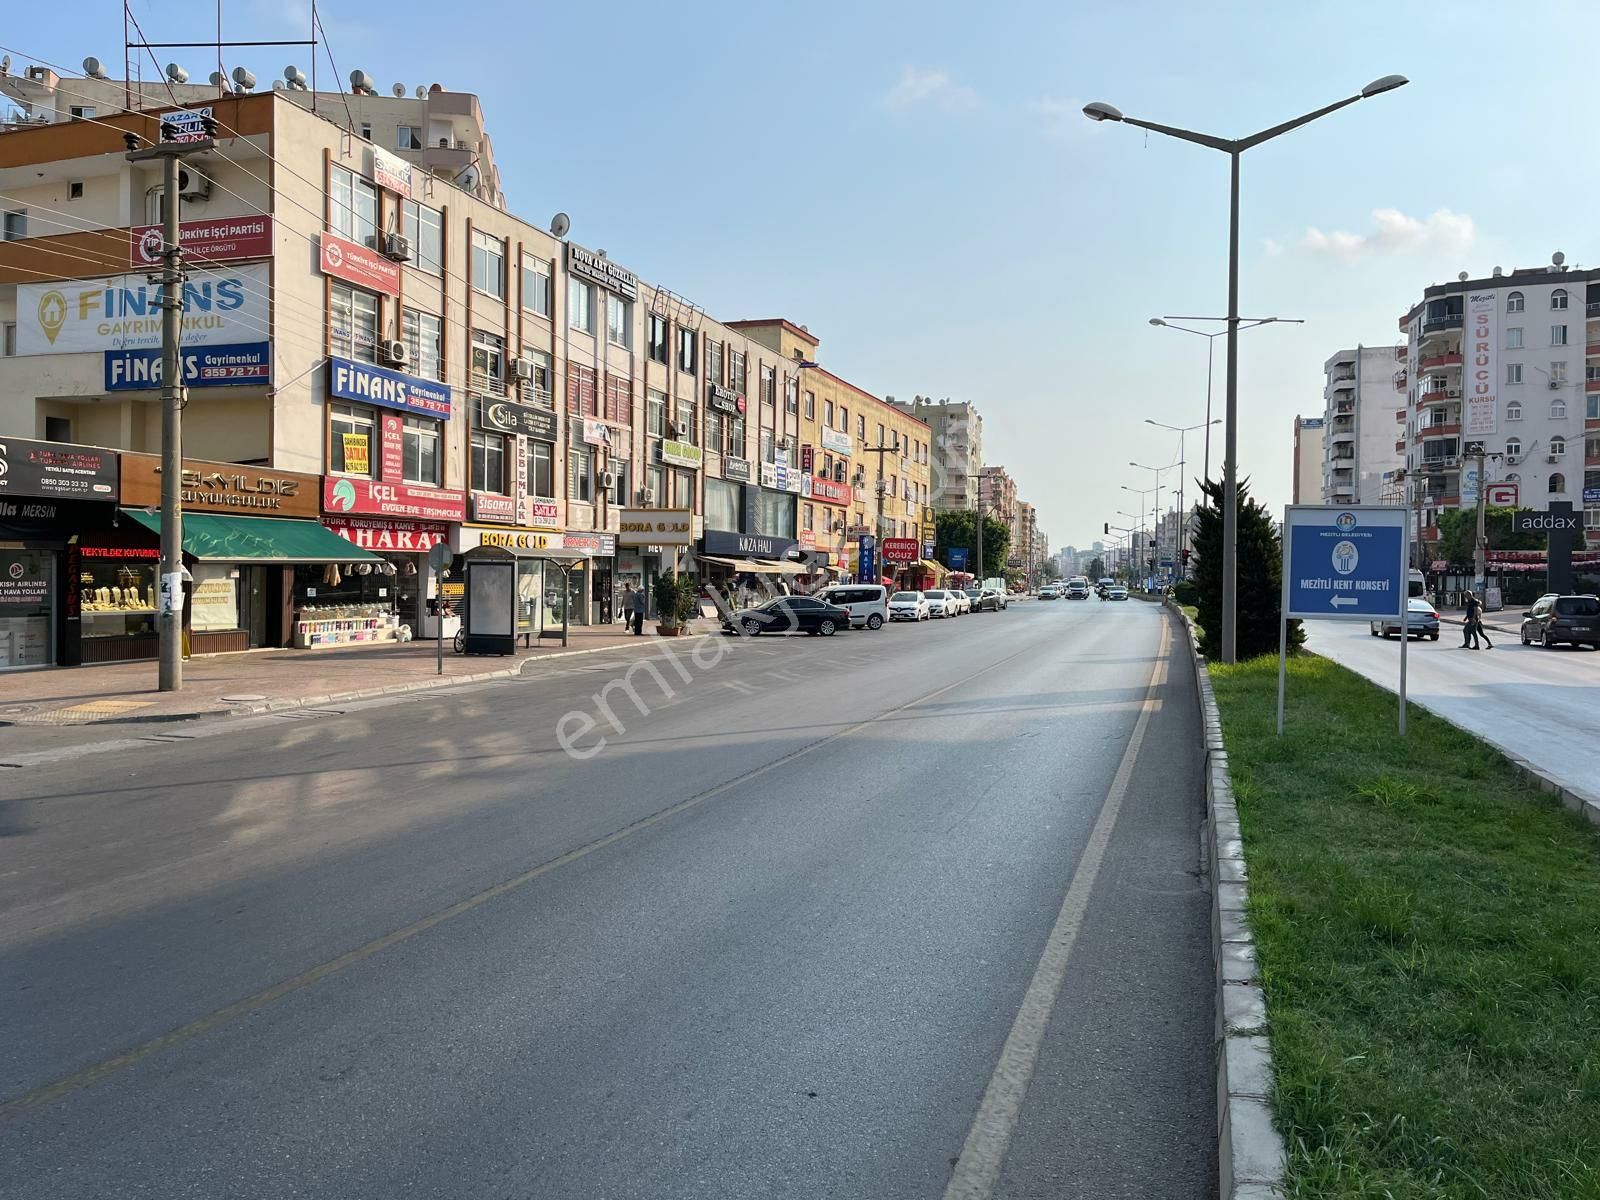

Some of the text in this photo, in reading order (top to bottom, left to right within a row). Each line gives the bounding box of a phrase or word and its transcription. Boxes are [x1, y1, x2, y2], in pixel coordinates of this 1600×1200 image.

[179, 227, 210, 240] ÜRKİYE
[230, 222, 264, 236] PARTİSİ
[98, 316, 225, 336] GAYRİMNKUL
[1475, 314, 1489, 395] SÜRÜCÜ
[112, 353, 260, 385] FİNAS Gayrimenkul
[205, 366, 261, 380] 359 72 71
[337, 364, 407, 404] FİNANS
[410, 397, 447, 411] 359 72 71
[1469, 395, 1496, 404] KURSU
[368, 482, 399, 503] İÇEL
[620, 523, 652, 532] BORA
[1522, 514, 1576, 529] addax
[325, 527, 445, 549] AHARAT
[481, 533, 514, 548] BORA
[888, 550, 912, 559] OĞUZ
[17, 581, 47, 589] AIRLINES
[1300, 577, 1390, 591] MEZİTLİ KENT KONSEYİ
